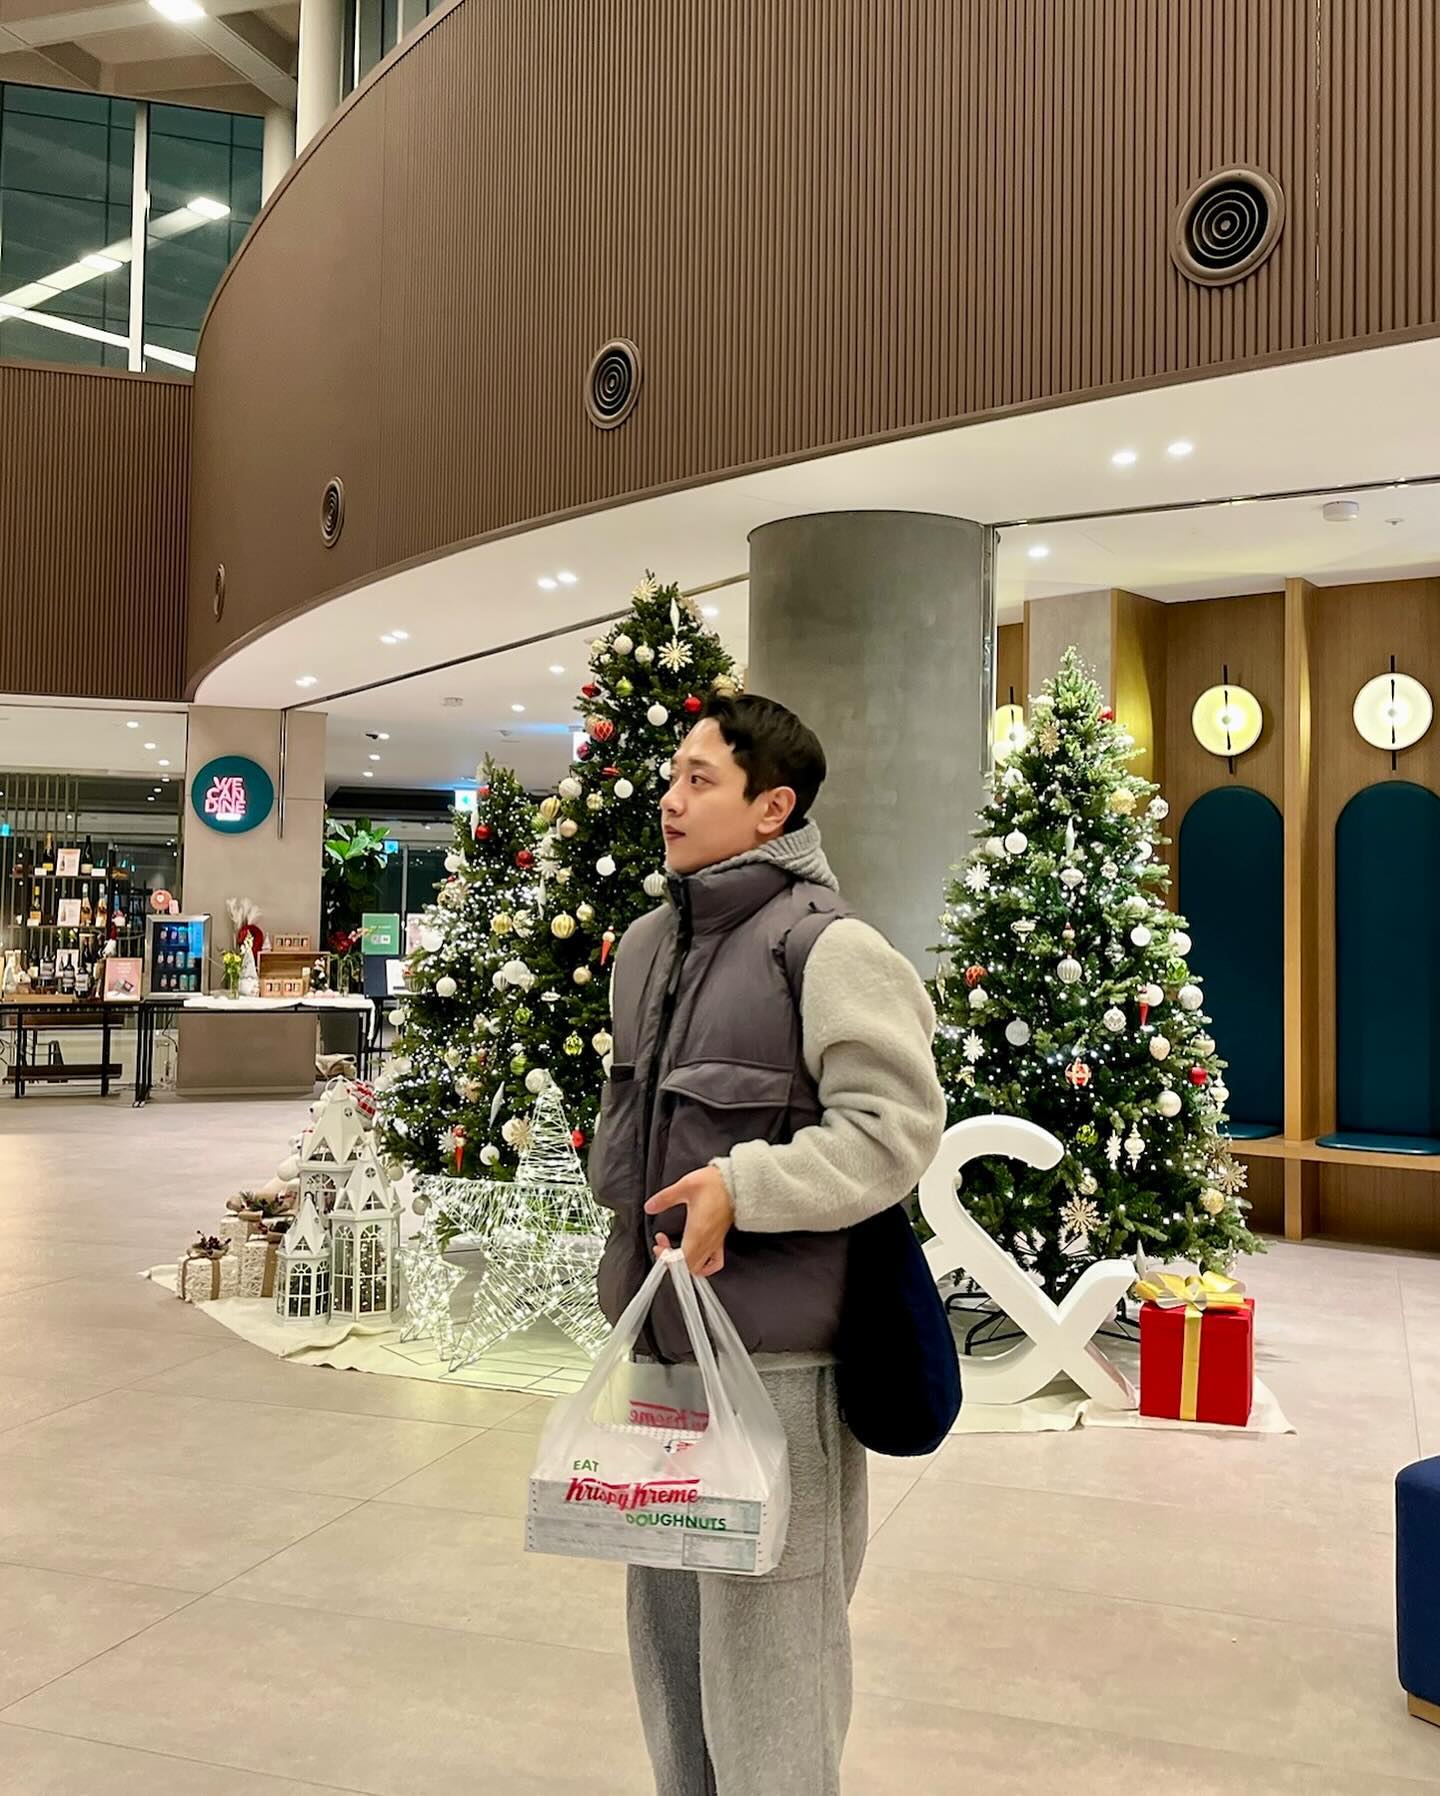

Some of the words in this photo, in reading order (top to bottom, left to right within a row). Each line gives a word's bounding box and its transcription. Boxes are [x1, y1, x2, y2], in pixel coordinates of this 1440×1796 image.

[213, 776, 243, 789] WE
[206, 787, 245, 801] CAN
[204, 799, 247, 814] DINE
[573, 1459, 599, 1472] EAT
[565, 1477, 630, 1511] Krispy
[629, 1478, 701, 1509] Kreme
[626, 1513, 726, 1531] DOUGHNUTS
